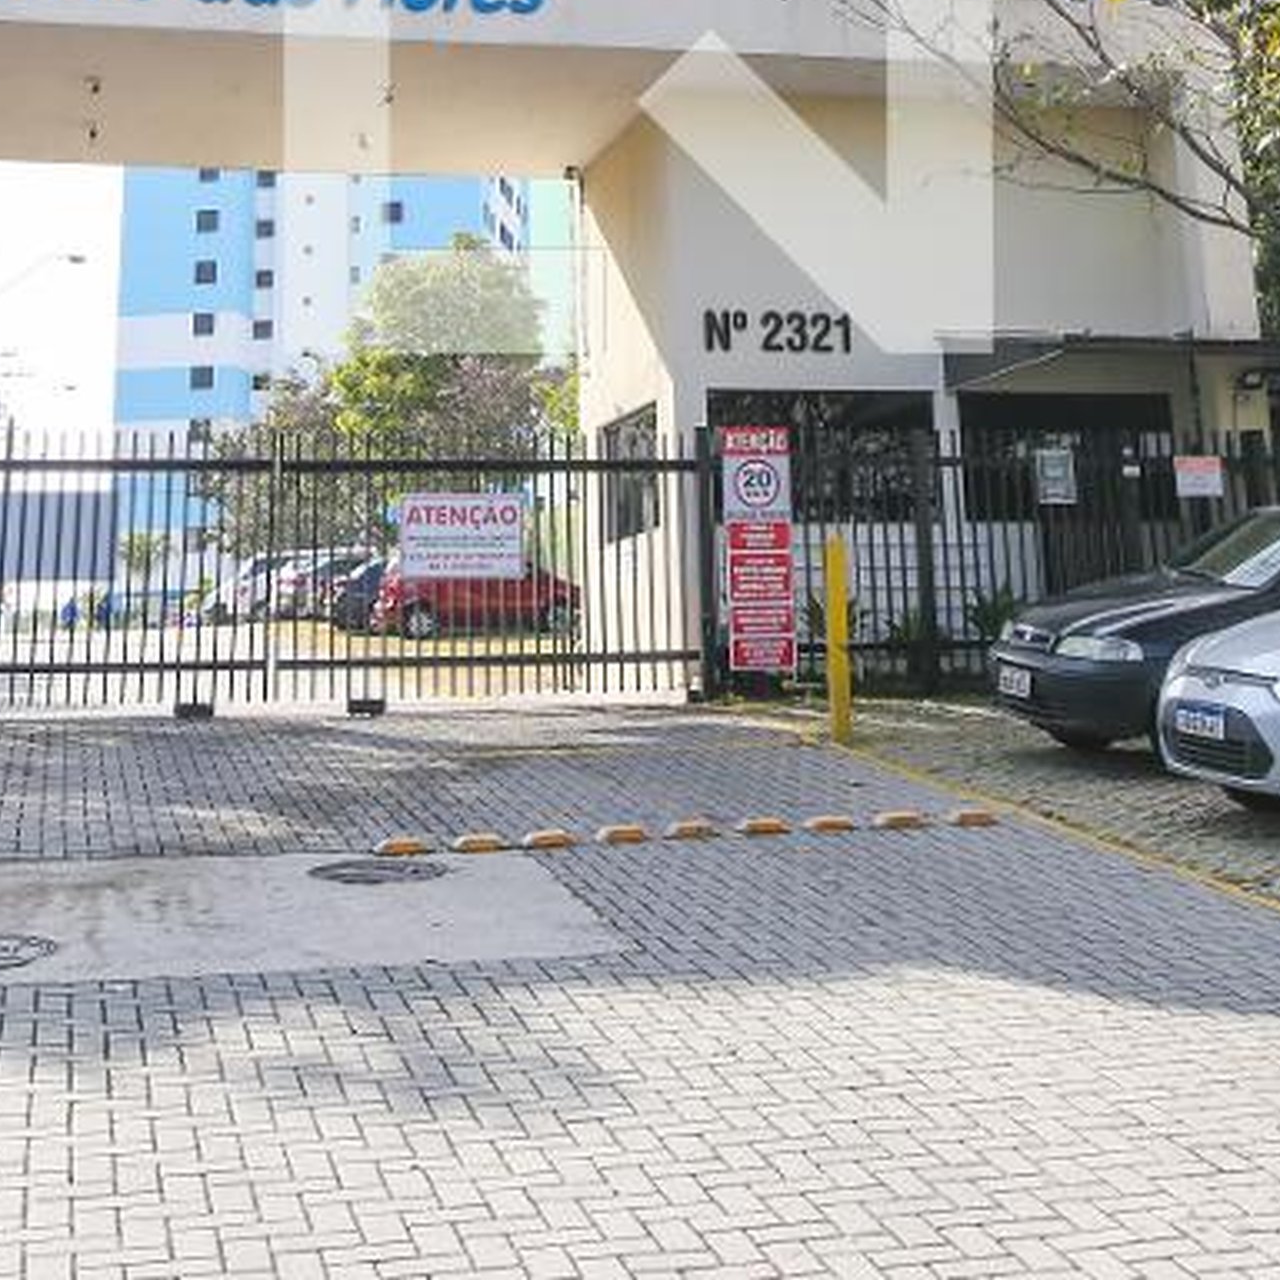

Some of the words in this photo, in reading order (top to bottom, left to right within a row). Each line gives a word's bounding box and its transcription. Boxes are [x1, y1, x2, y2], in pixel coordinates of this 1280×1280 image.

[704, 308, 747, 352] Nº
[760, 310, 851, 353] 2321
[743, 468, 772, 488] 20
[406, 498, 518, 531] ATENÇÃO
